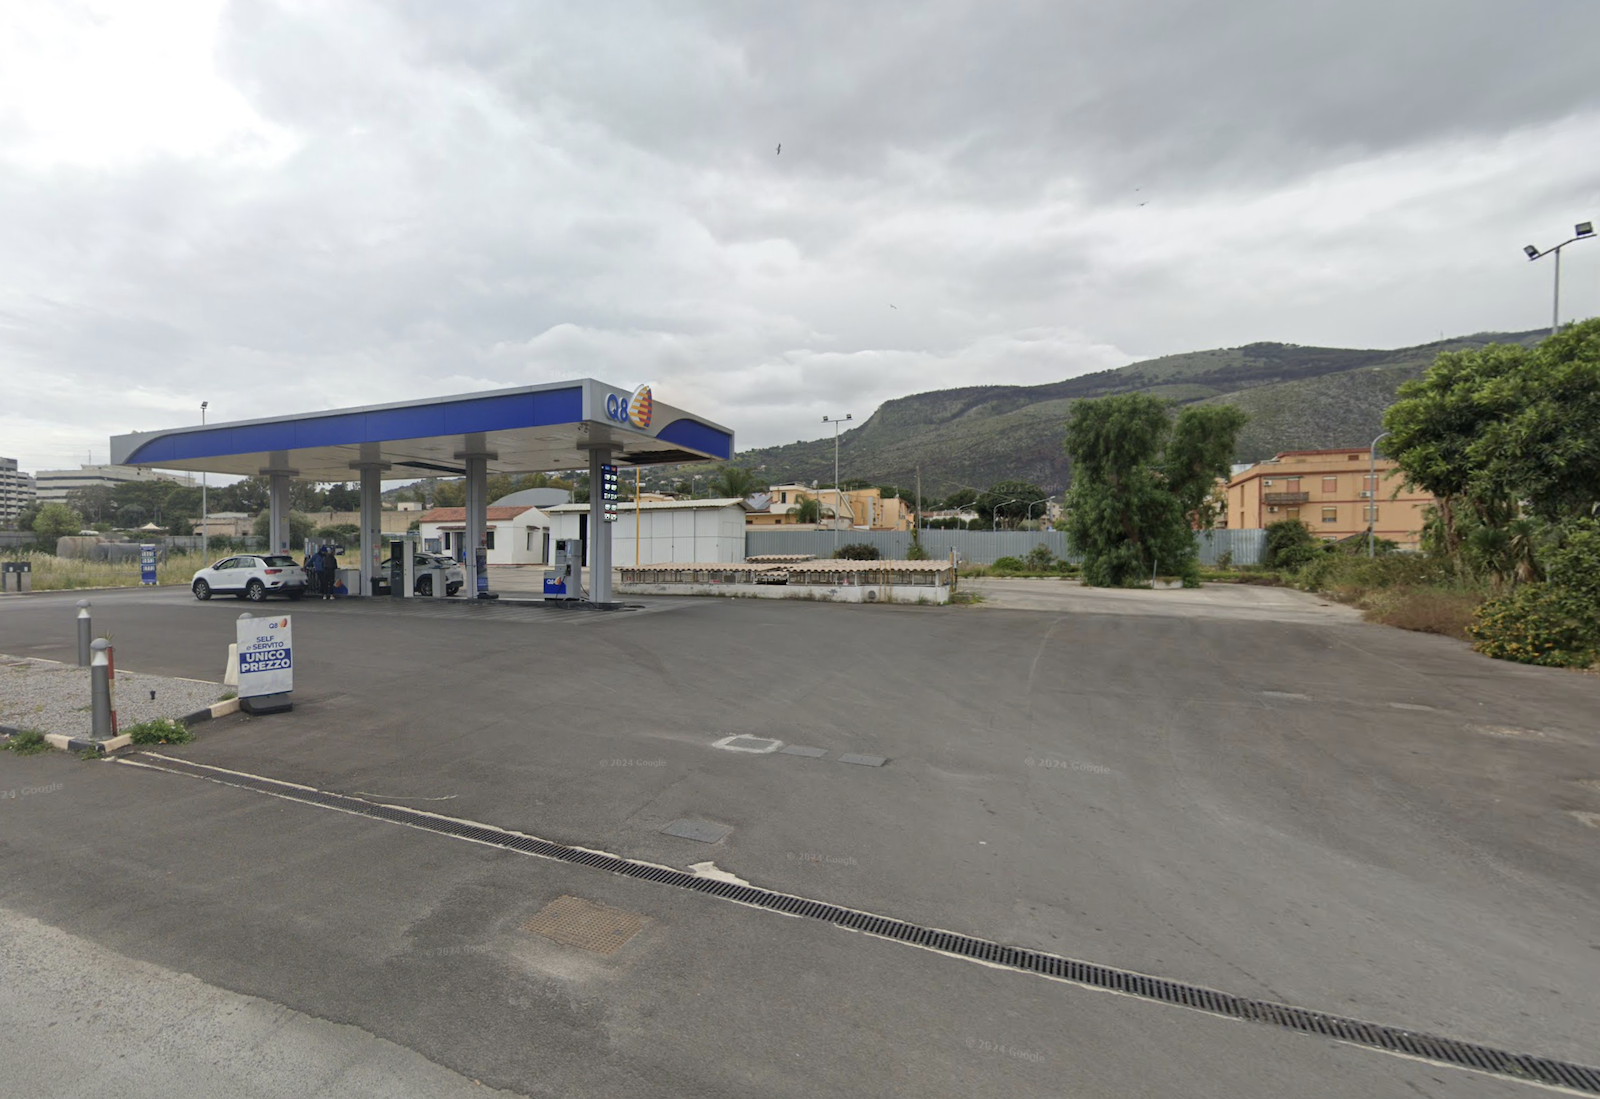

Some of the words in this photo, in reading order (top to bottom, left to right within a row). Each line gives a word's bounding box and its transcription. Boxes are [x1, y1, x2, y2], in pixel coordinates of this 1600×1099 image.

[604, 393, 629, 424] Q8
[252, 641, 284, 650] SERVITO
[256, 635, 274, 643] SELF
[246, 649, 285, 662] UNICO
[241, 658, 290, 673] PREZZO
